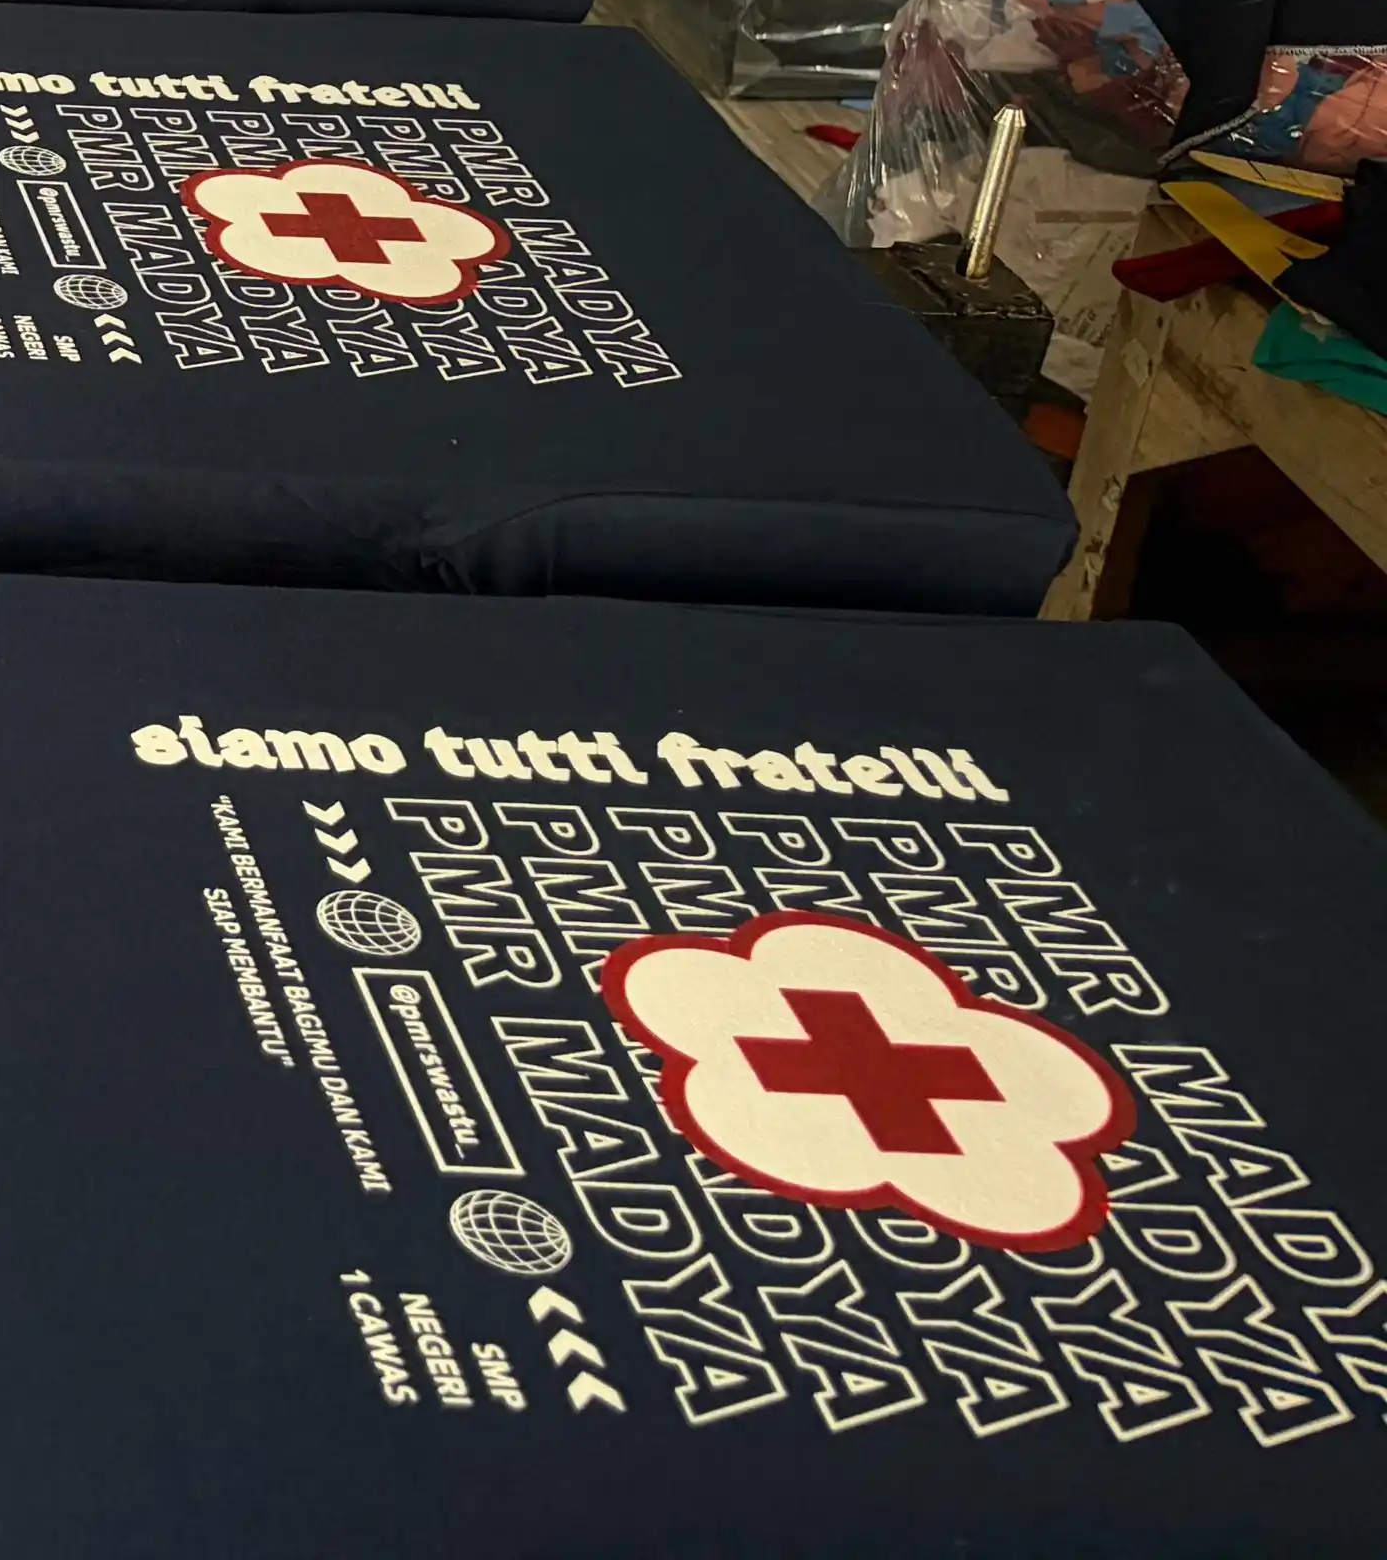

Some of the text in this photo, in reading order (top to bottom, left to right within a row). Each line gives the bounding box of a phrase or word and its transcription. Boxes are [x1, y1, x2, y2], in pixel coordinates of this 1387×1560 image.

[88, 70, 239, 100] tutti
[247, 75, 481, 110] fratelli
[204, 109, 293, 168] PM
[279, 112, 373, 166] PM
[55, 103, 245, 370] PMR MADYA
[432, 118, 550, 207] PMR
[503, 217, 683, 388] MADYA
[13, 315, 50, 361] NEGERI
[53, 336, 82, 363] SMP
[473, 260, 594, 383] ADYA
[130, 715, 1007, 801] siamo tutti fratelli
[203, 887, 241, 934] SIAP
[605, 806, 758, 933] PM
[717, 811, 881, 927] PM
[230, 853, 304, 982] BERMANFAAT
[282, 985, 340, 1071] BAGIMU
[319, 1076, 363, 1123] DAN
[341, 1129, 392, 1191] KAMI
[388, 984, 479, 1159] @pmrswastu_
[383, 797, 787, 1425] PMR MADYA
[944, 821, 1166, 1015] PMR
[1108, 1042, 1387, 1424] MADY
[340, 1269, 418, 1403] 1 CAWAS
[398, 1293, 473, 1406] NEGERI
[1102, 1142, 1353, 1447] ADYA
[471, 1343, 526, 1409] SMP
